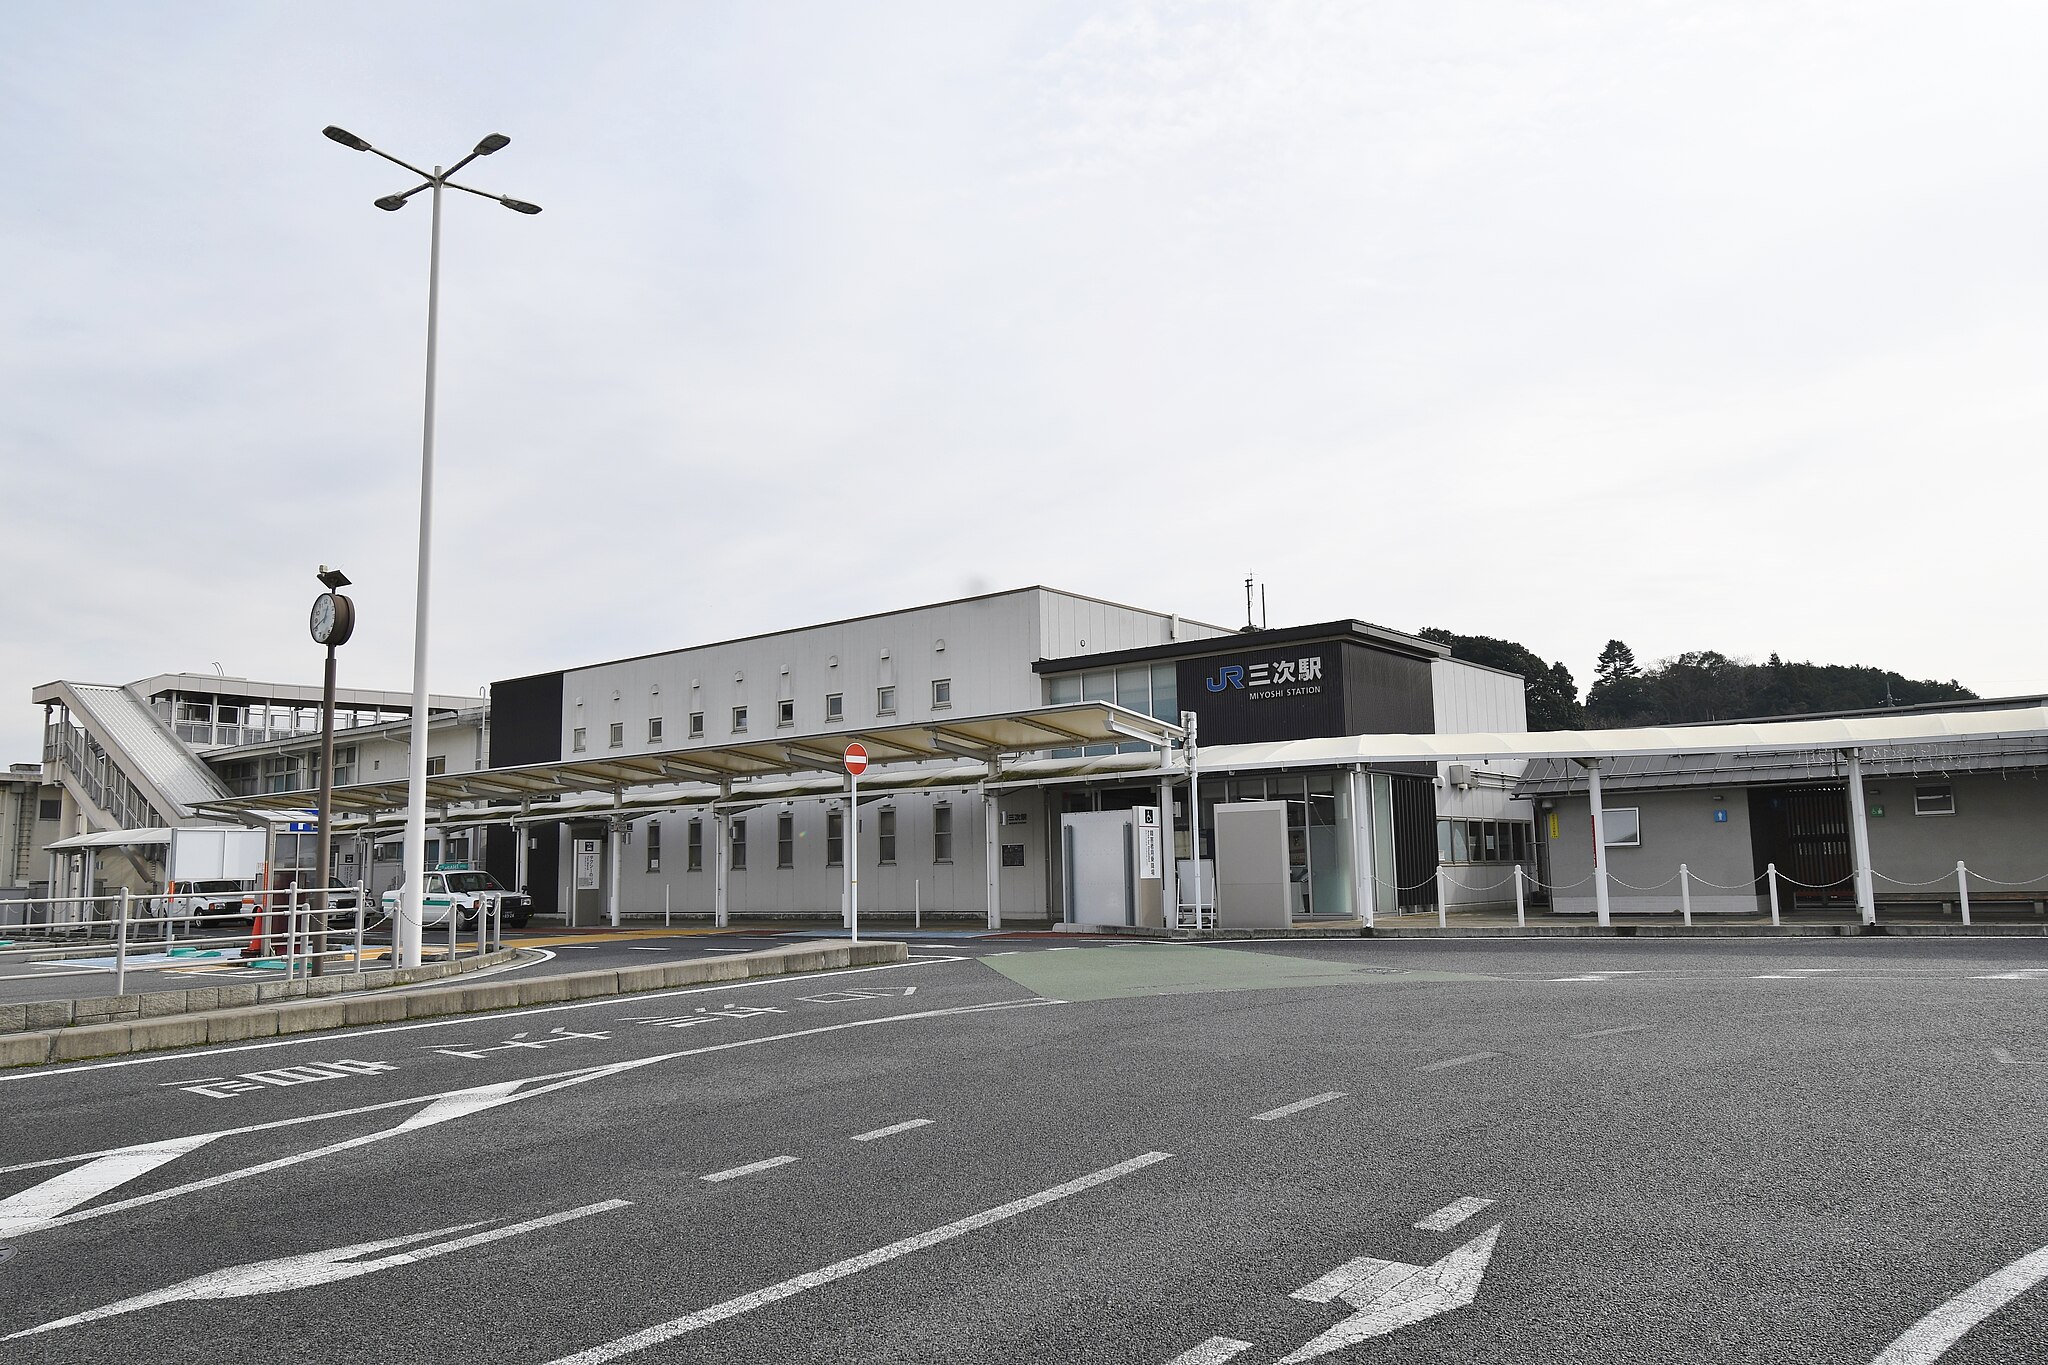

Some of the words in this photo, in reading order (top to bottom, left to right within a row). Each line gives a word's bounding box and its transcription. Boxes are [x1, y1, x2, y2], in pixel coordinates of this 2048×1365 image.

[1206, 665, 1245, 692] JR
[1248, 656, 1322, 687] 三次駅
[1249, 690, 1284, 700] MIYOSHI
[1286, 686, 1321, 696] STATION
